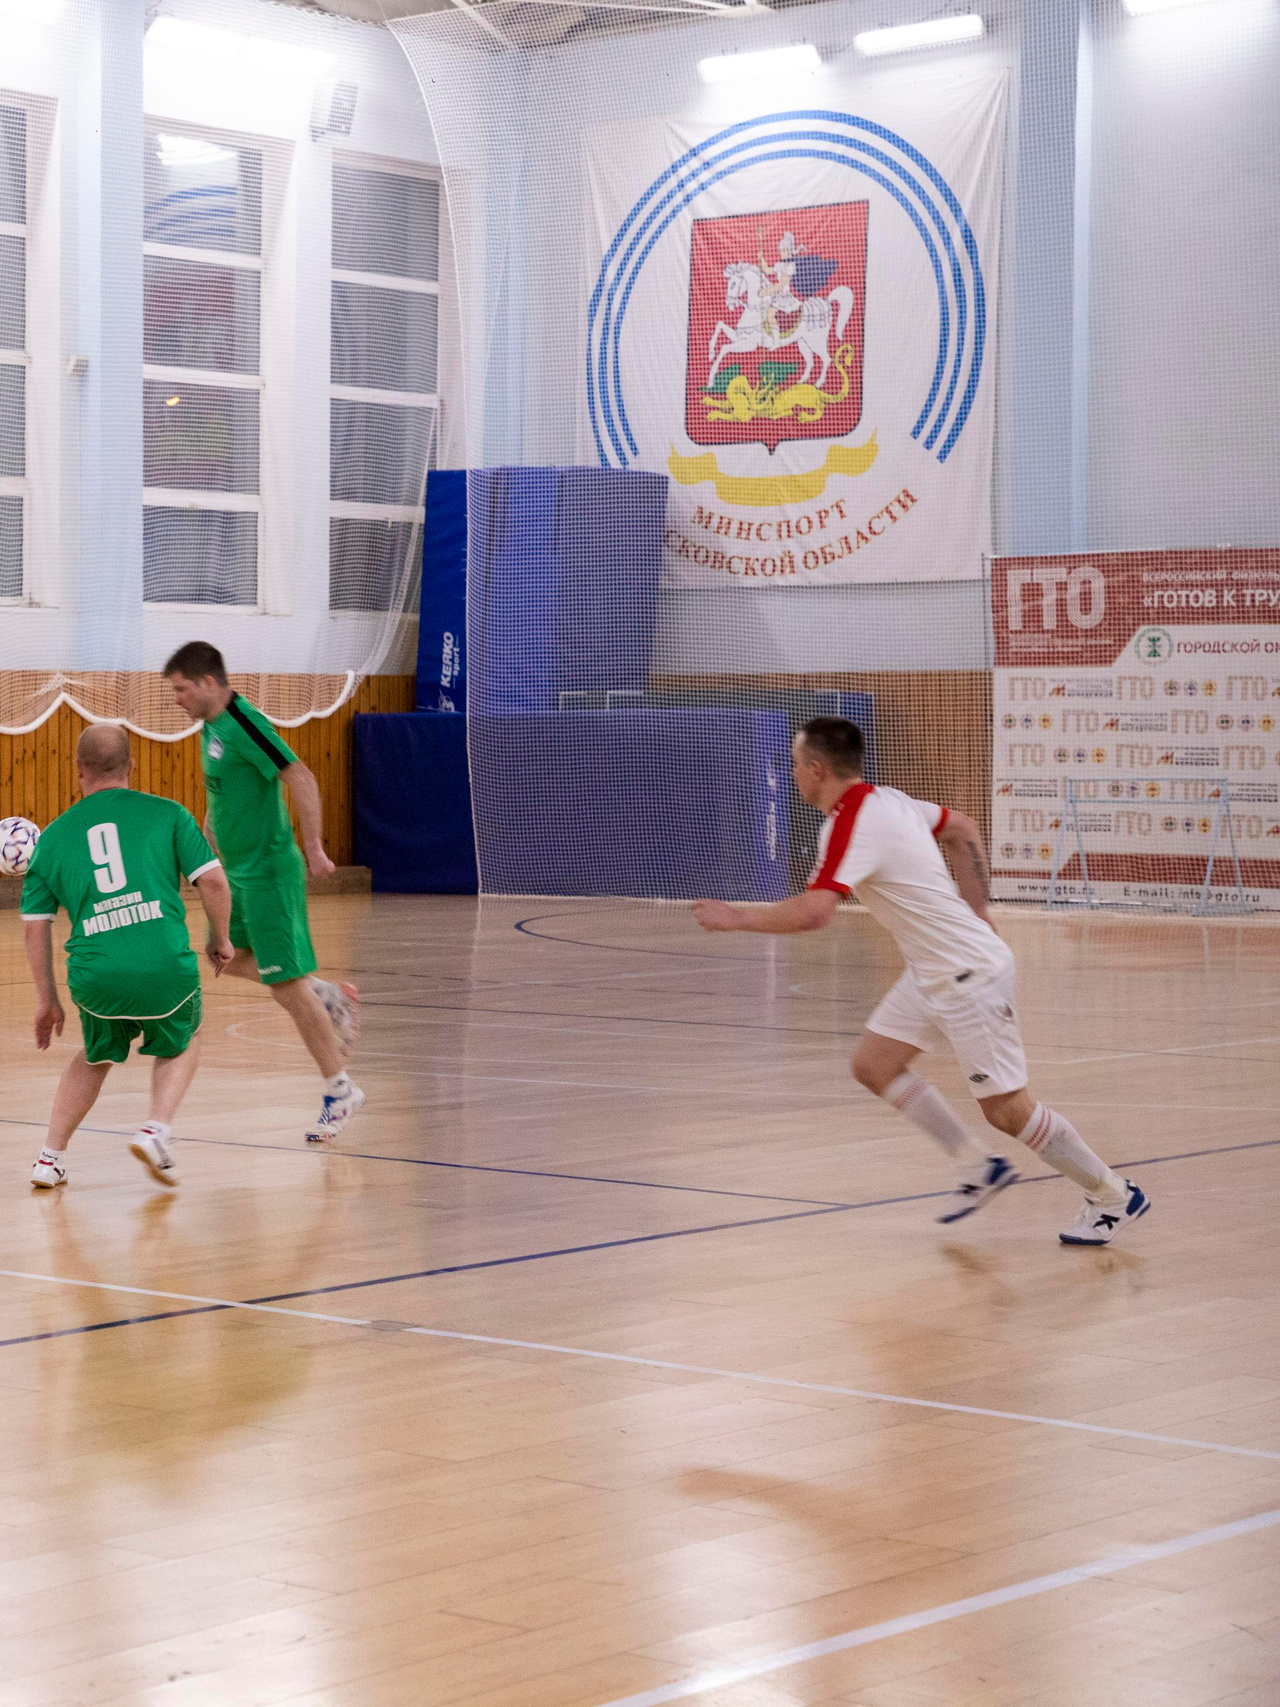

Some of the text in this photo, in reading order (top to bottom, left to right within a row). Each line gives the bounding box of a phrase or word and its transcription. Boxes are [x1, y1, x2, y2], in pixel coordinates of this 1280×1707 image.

[691, 499, 848, 542] МИНСПОРТ
[802, 487, 919, 571] ОБЛАСТИ
[1007, 566, 1105, 630] ГТО
[1142, 589, 1217, 608] «ГОТОВ
[1223, 589, 1237, 607] К
[440, 631, 454, 688] KERKO
[1177, 638, 1260, 654] ГОРОДСКОЙ
[87, 822, 128, 894] 9
[82, 900, 164, 937] МОЛОТОК
